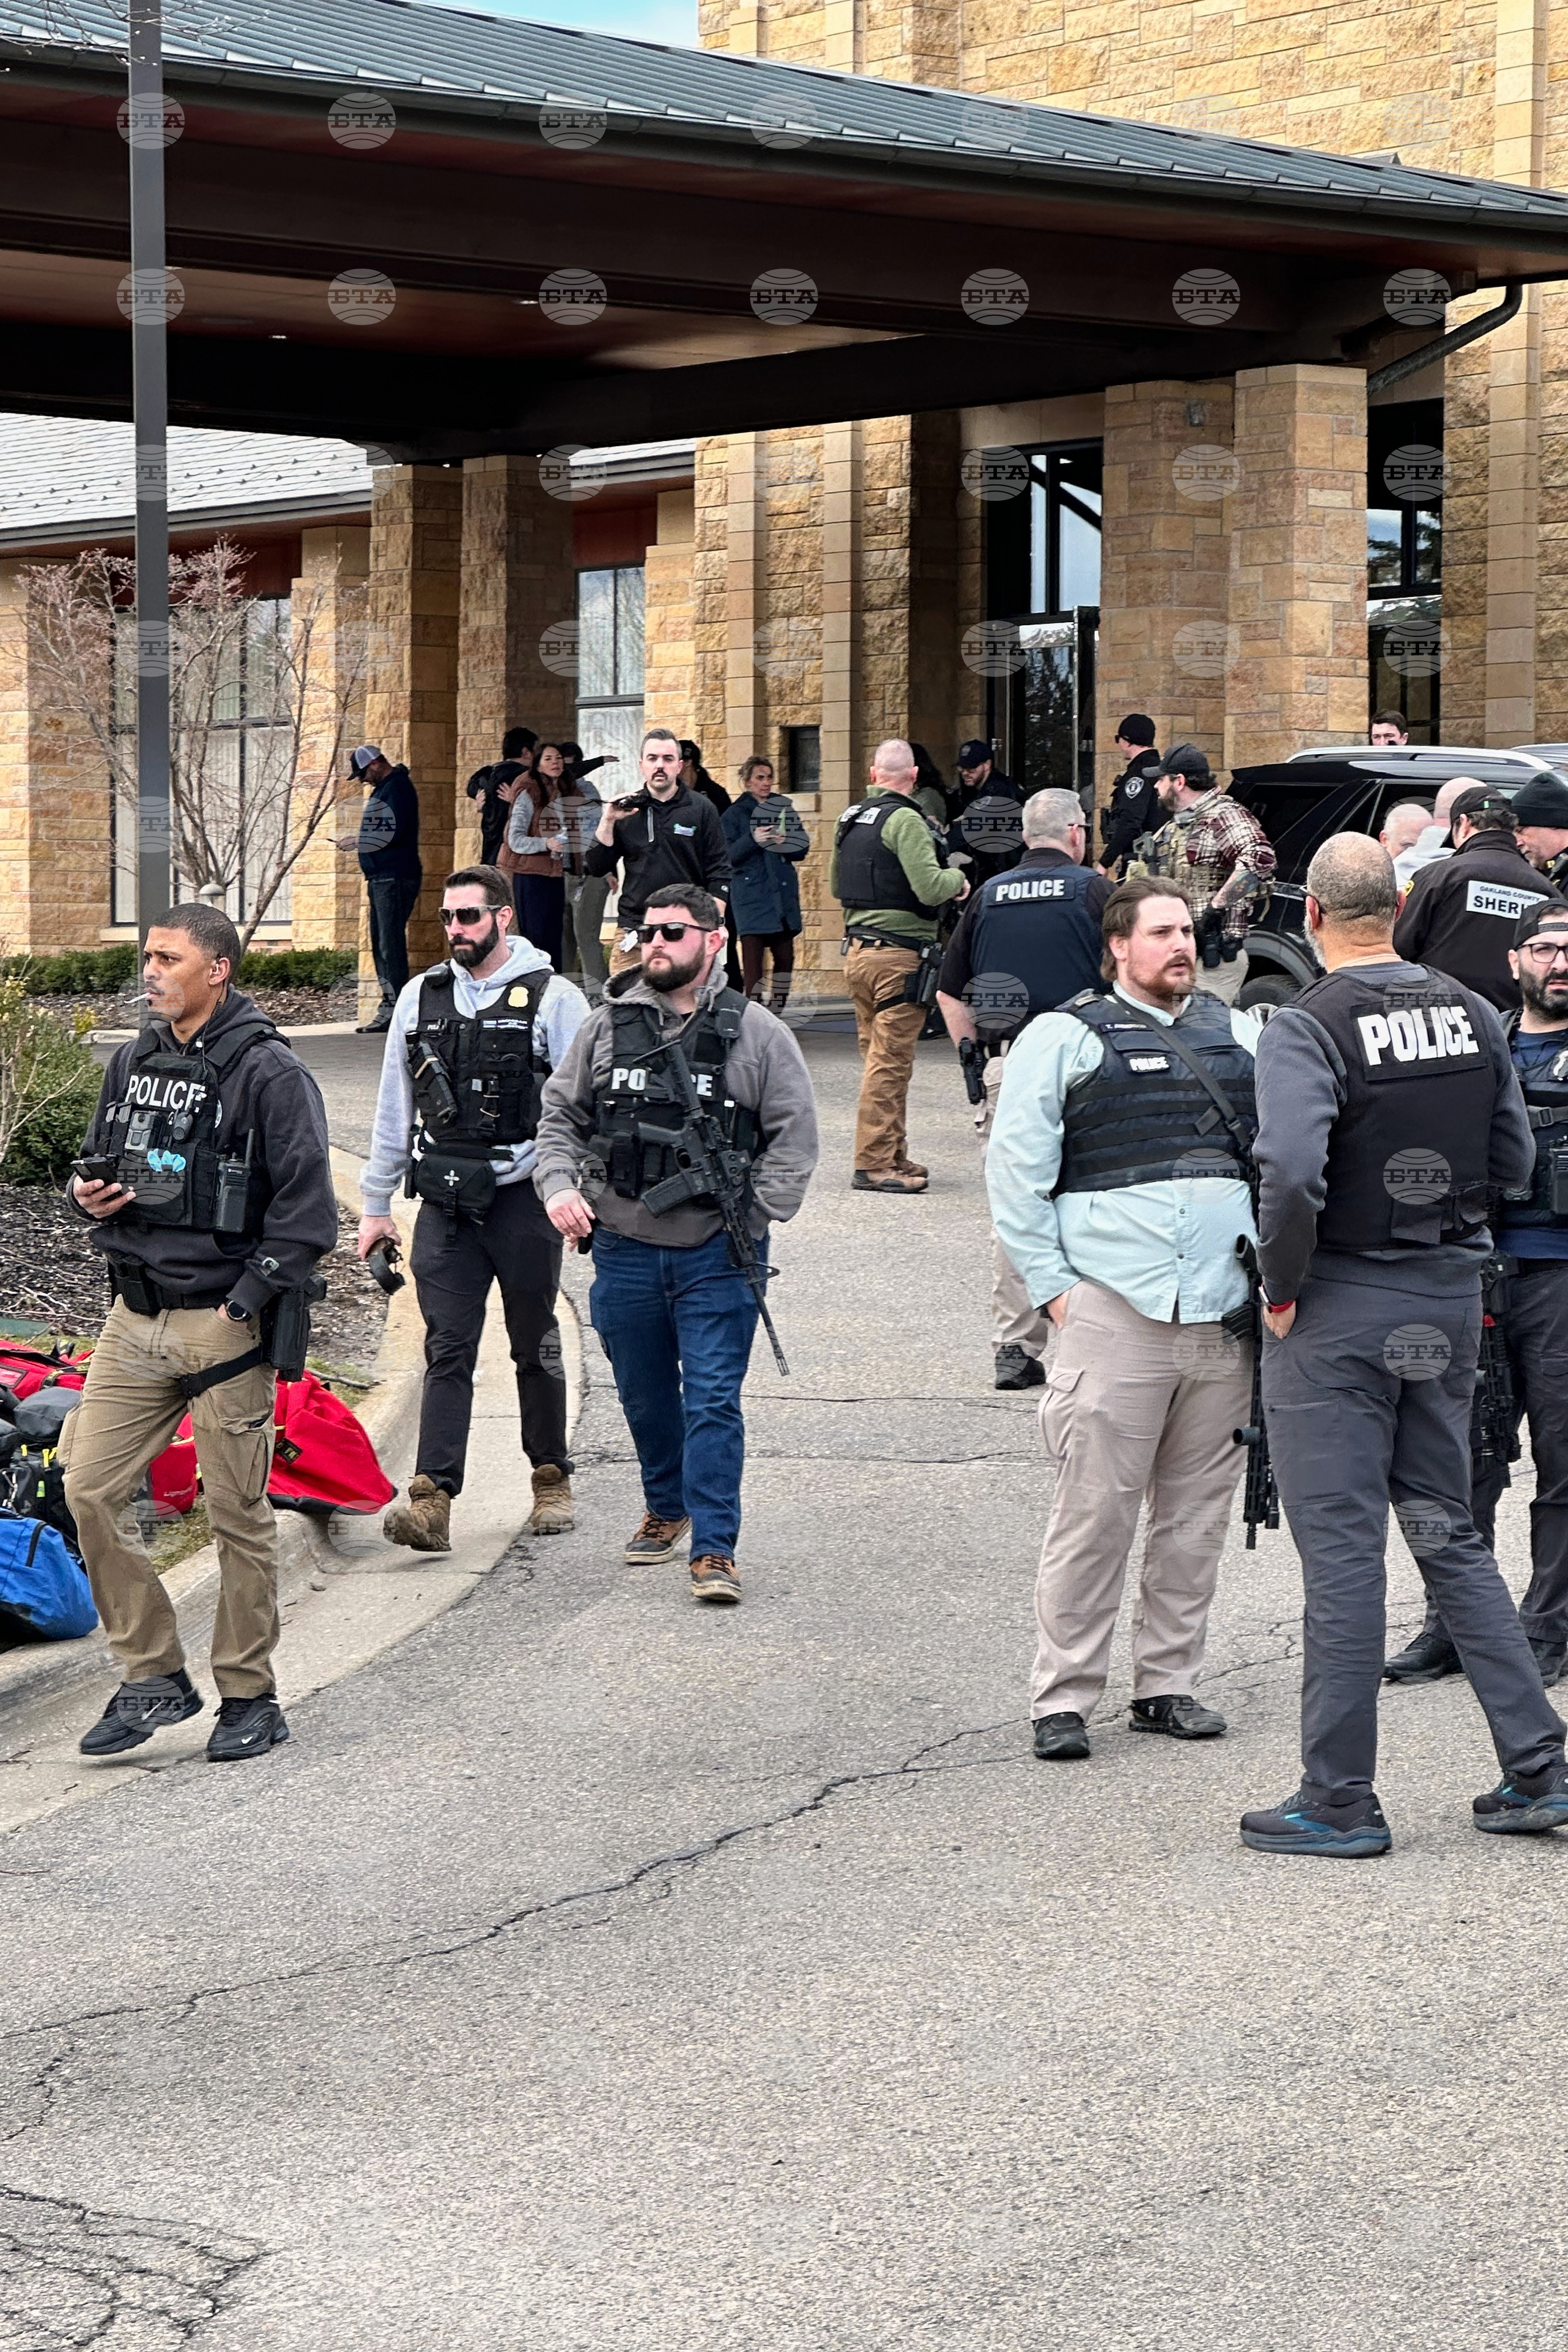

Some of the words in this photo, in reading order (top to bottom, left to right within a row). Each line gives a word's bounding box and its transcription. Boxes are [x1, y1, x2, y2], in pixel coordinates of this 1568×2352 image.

[996, 879, 1065, 902] POLICE
[1513, 892, 1540, 902] COUNTY
[1357, 1006, 1479, 1066] POLICE
[611, 1068, 713, 1097] POE
